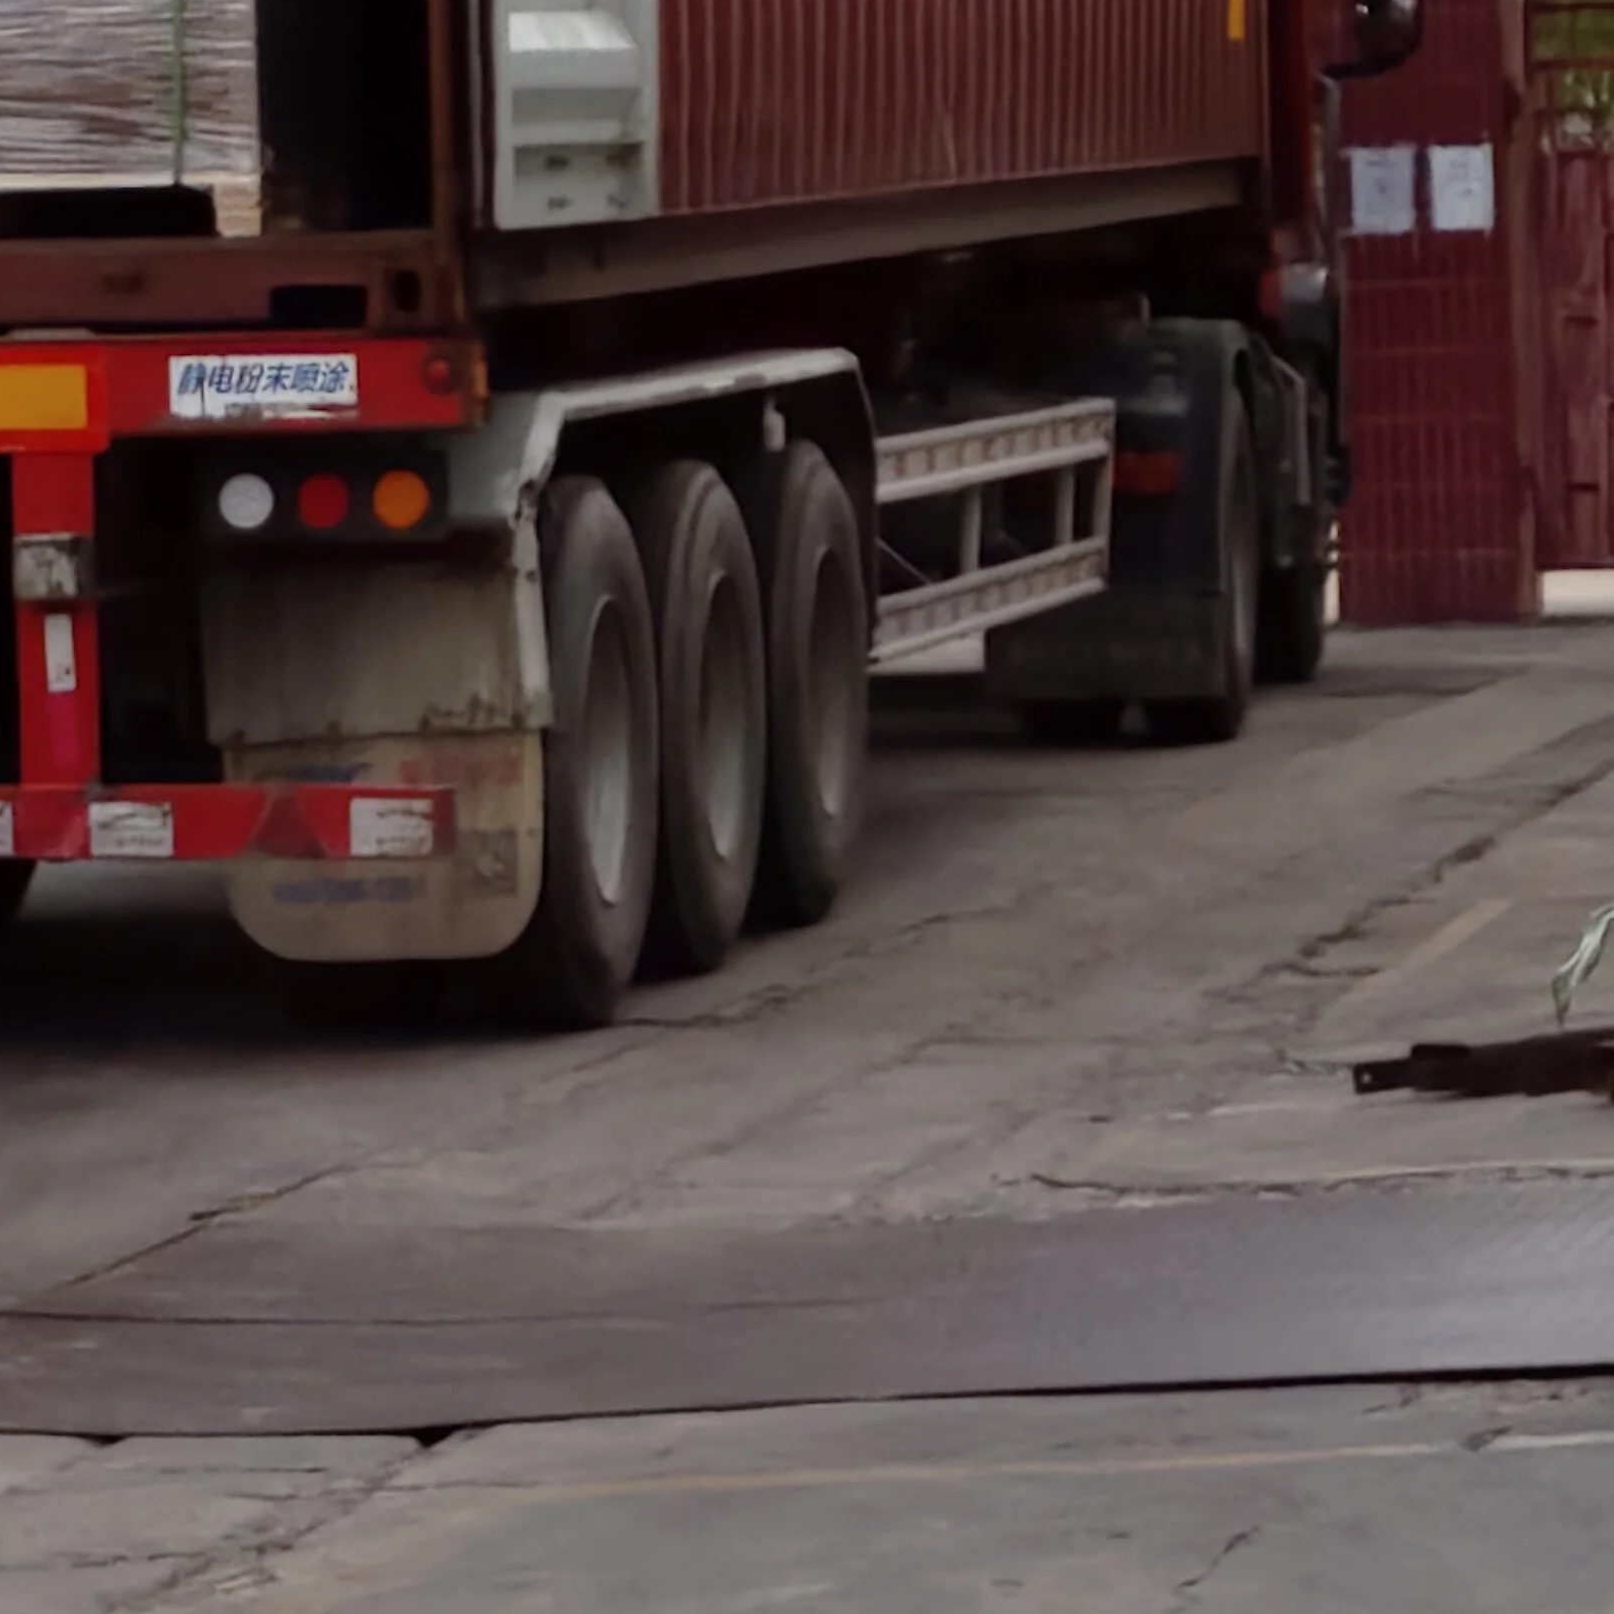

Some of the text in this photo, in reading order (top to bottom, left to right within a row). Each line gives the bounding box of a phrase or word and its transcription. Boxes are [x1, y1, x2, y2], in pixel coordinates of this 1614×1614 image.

[178, 361, 350, 395] 静电粉末喷涂
